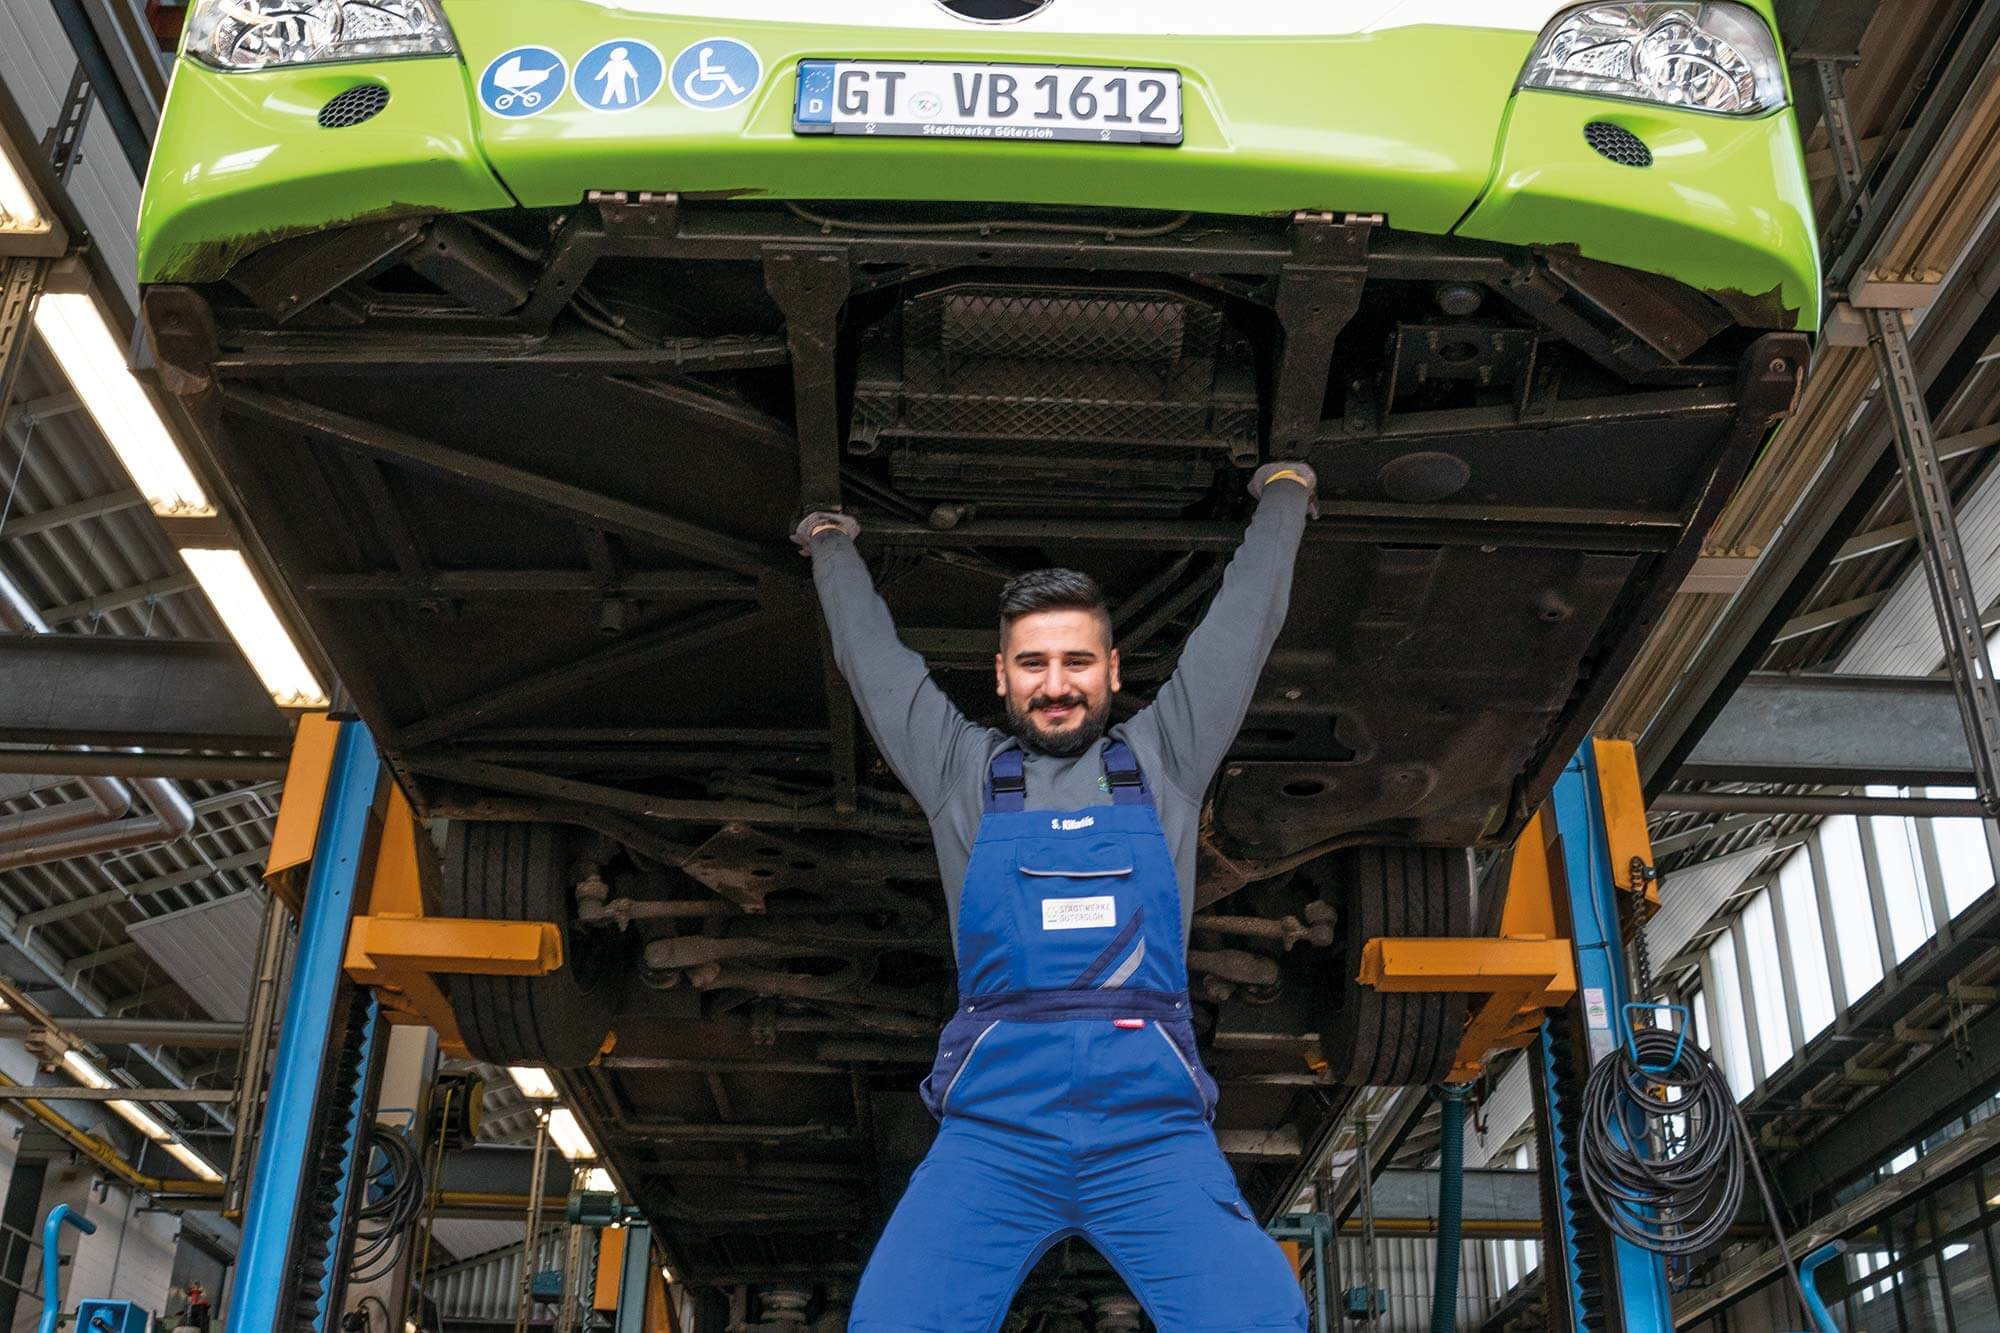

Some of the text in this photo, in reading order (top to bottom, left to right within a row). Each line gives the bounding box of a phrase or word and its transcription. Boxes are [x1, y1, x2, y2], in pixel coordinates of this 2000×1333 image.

[838, 70, 1167, 124] GT VB 1612
[809, 98, 824, 113] D
[922, 124, 1054, 138] Stadtwerke Gütersloh
